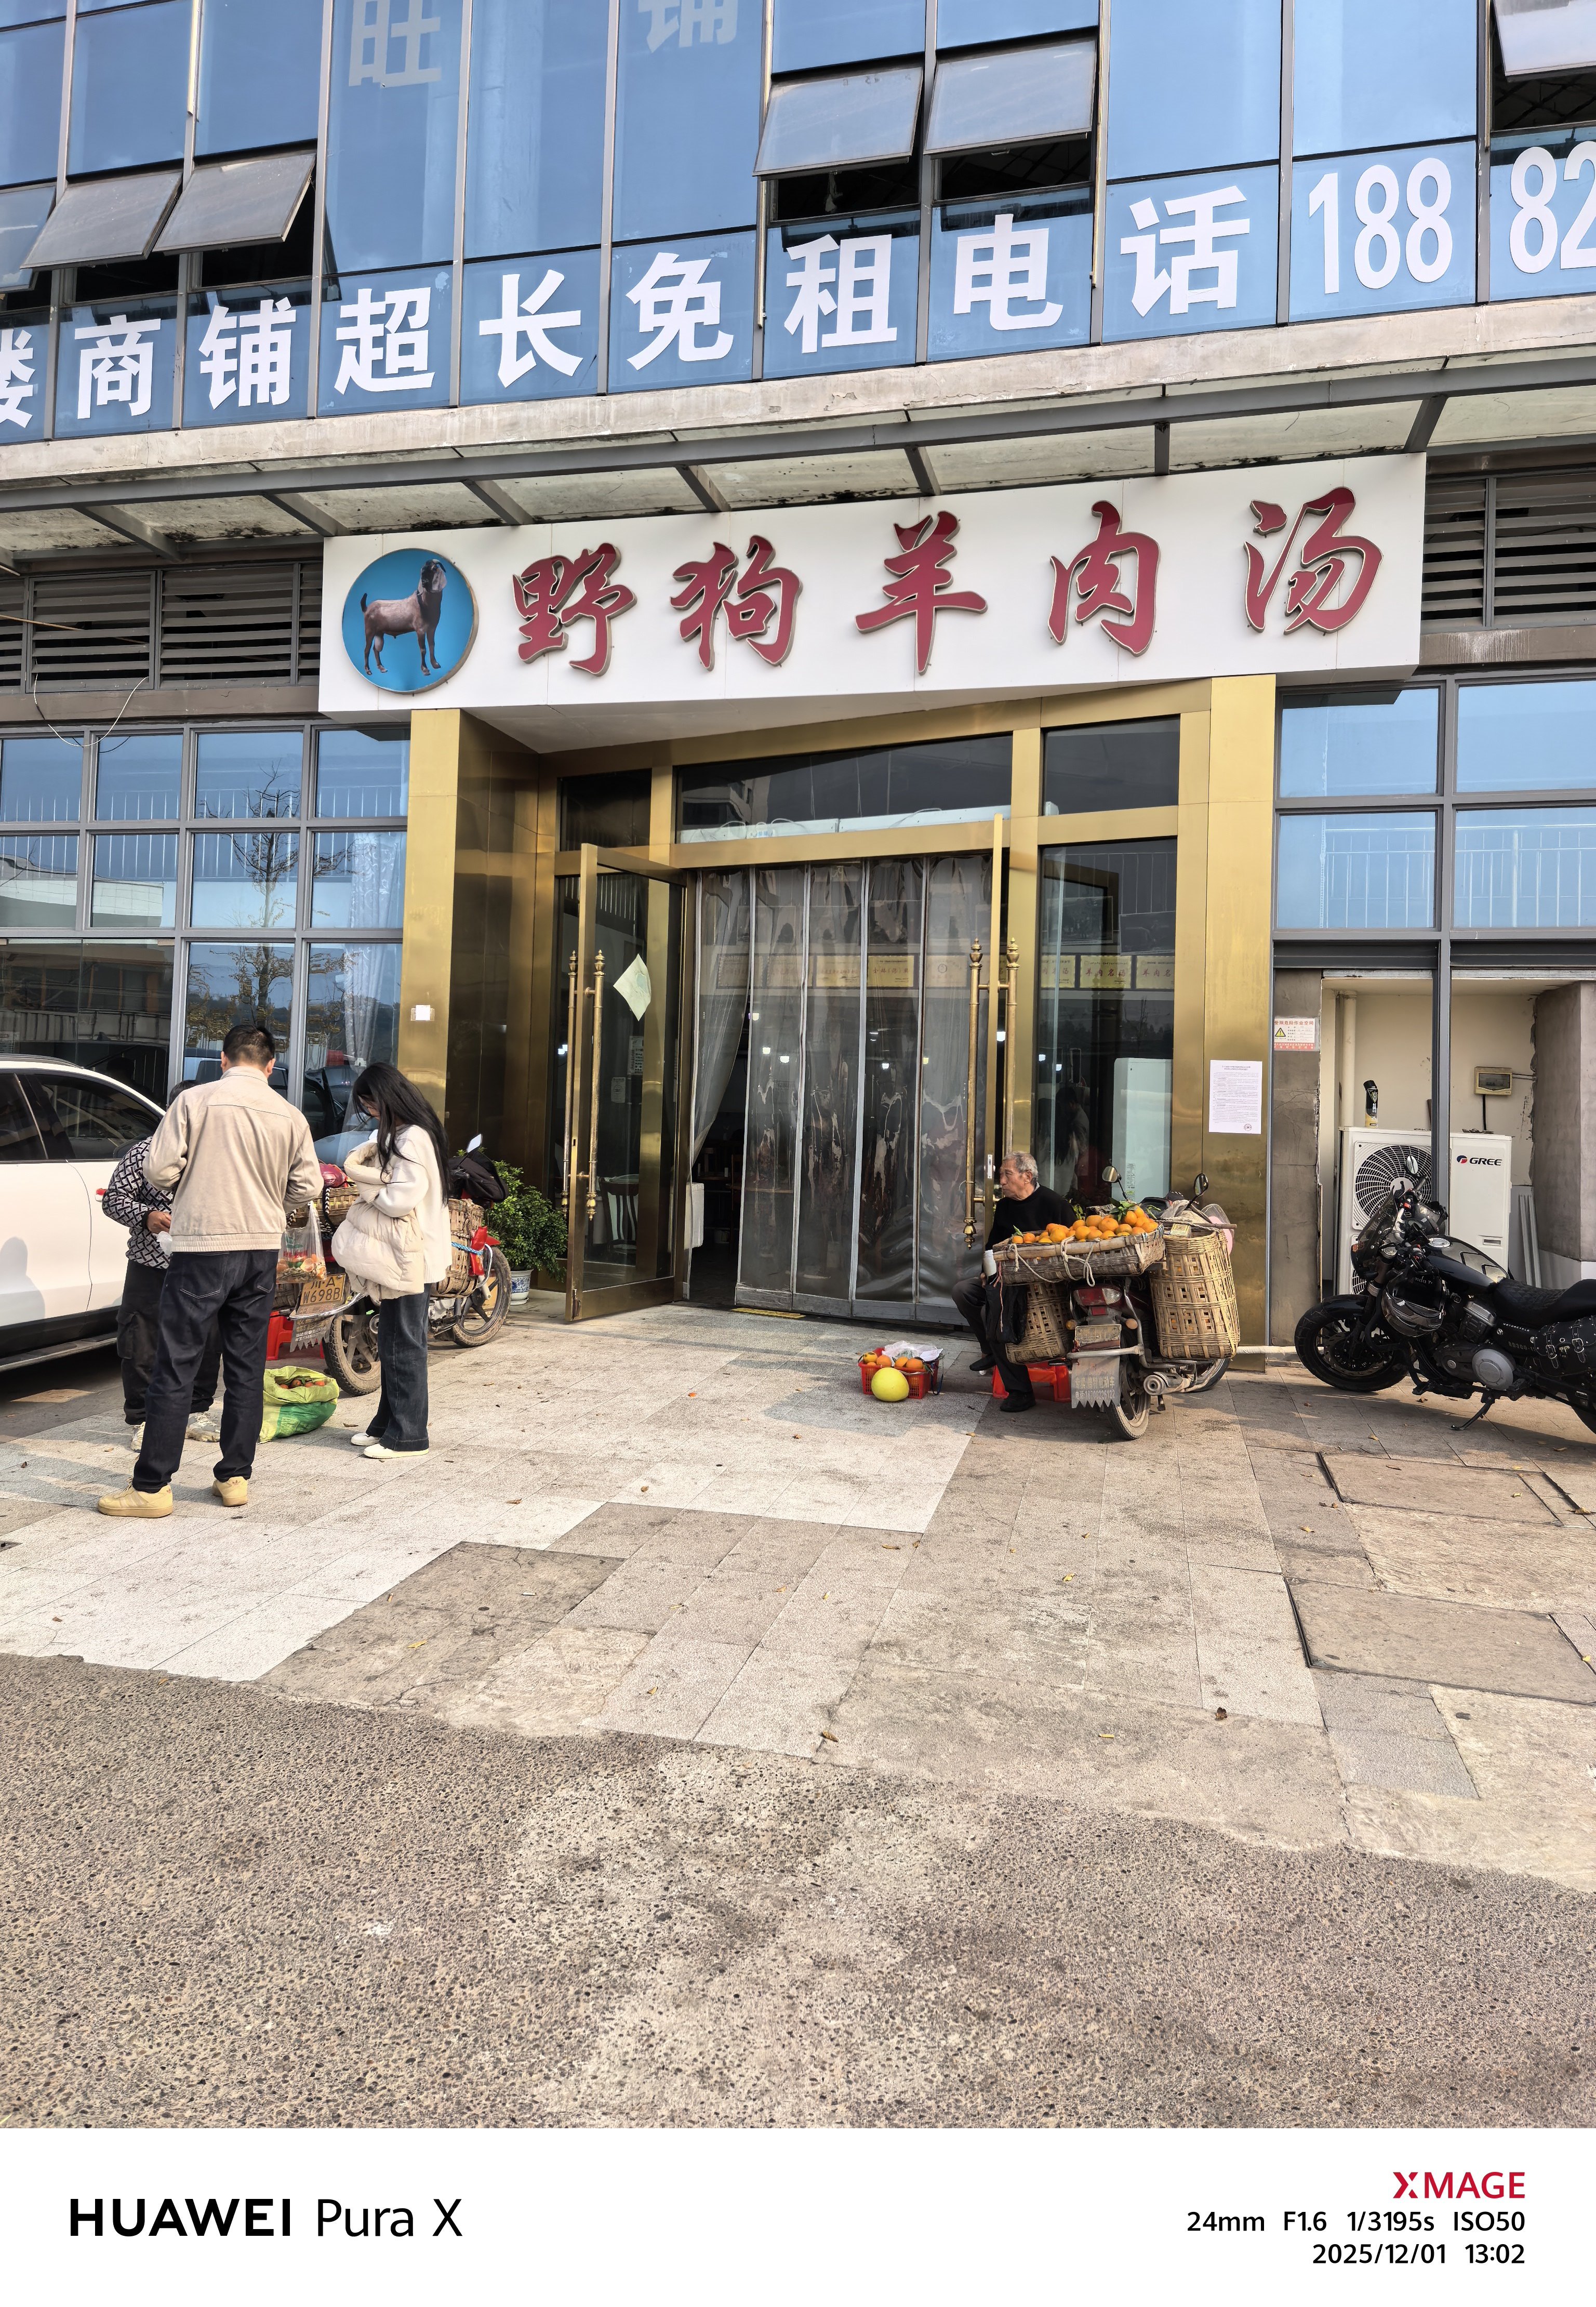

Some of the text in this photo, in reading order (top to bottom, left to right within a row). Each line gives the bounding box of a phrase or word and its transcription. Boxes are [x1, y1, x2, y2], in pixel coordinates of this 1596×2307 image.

[1309, 157, 1453, 295] 188
[511, 487, 1384, 677] 野狗羊肉汤
[1469, 1157, 1502, 1166] GREE
